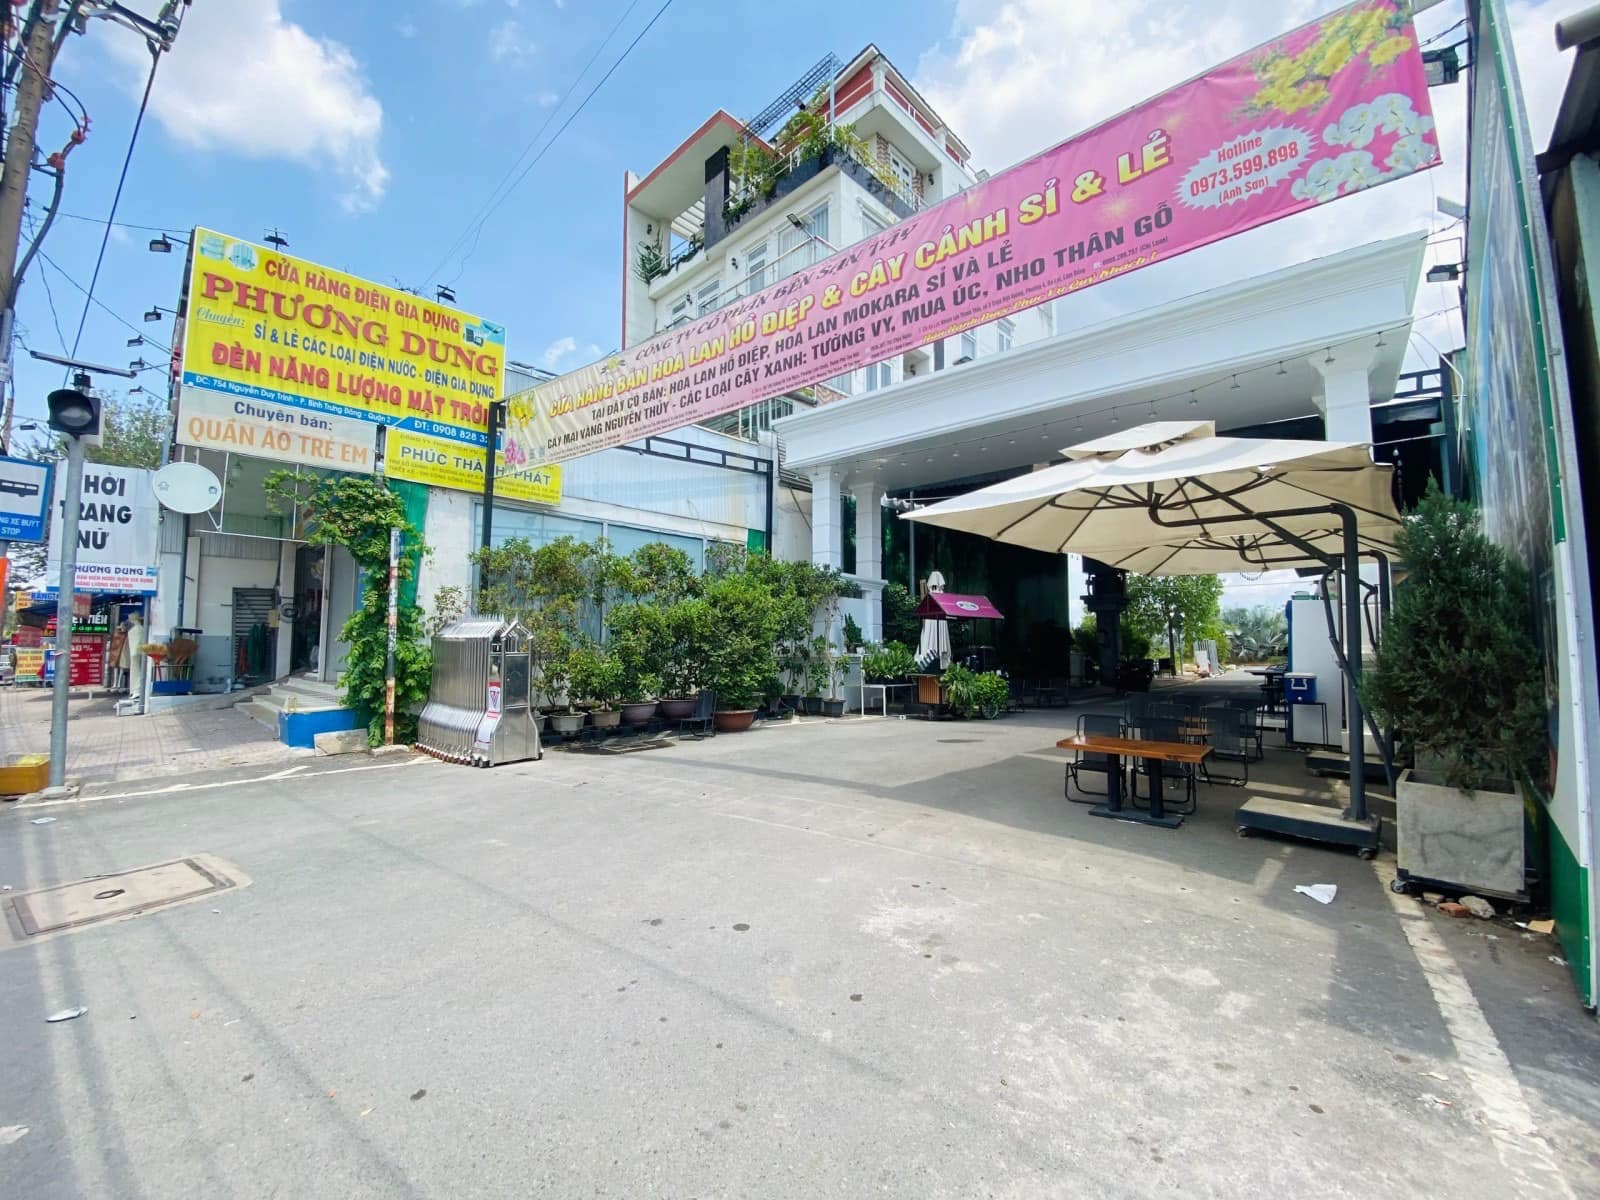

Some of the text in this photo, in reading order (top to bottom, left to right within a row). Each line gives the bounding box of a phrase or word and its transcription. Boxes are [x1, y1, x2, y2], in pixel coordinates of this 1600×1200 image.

[1218, 136, 1263, 163] Hotline
[1190, 141, 1299, 197] 0973.599.898
[1219, 176, 1270, 204] (Anh Sơn)
[575, 383, 614, 410] HÀNG
[616, 366, 648, 395] BÁN
[651, 352, 685, 382] HOA
[688, 335, 726, 368] LAN
[761, 294, 815, 336] ĐIỆP
[821, 284, 844, 310] &
[850, 251, 907, 297] CÂY
[914, 207, 1009, 270] CẢNH
[1018, 177, 1060, 225] SỈ
[1071, 170, 1105, 204] &
[1117, 128, 1173, 185] LẺ
[265, 257, 460, 334] CỬA HÀNG ĐIỆN GIA DỤNG
[201, 271, 499, 378] PHƯƠNG DUNG
[563, 431, 579, 446] MAI
[580, 424, 603, 440] VÀNG
[679, 389, 702, 409] CÁC
[705, 378, 731, 399] LOẠI
[735, 367, 760, 389] CÂY
[764, 351, 807, 379] XANH:
[811, 326, 866, 360] TƯỜNG
[902, 296, 946, 326] MUA
[996, 257, 1046, 291] NHO
[1053, 226, 1125, 269] THÂN
[1134, 199, 1173, 238] GỖ
[669, 376, 690, 395] HOA
[694, 366, 717, 386] LAN
[720, 353, 735, 376] HỒ
[775, 333, 803, 354] HOA
[807, 315, 837, 341] LAN
[842, 284, 920, 326] MOKARA
[952, 256, 980, 282] VÀ
[987, 239, 1014, 269] LẺ
[212, 340, 262, 374] ĐÈN
[268, 355, 330, 389] NĂNG
[336, 372, 402, 405] LƯỢNG
[408, 389, 446, 418] MẶT
[270, 328, 279, 344] &
[283, 328, 299, 349] LẺ
[302, 334, 327, 356] CÁC
[330, 343, 355, 366] LOẠI
[359, 351, 385, 372] ĐIỆN
[388, 357, 417, 379] NƯỚC
[425, 369, 448, 389] ĐIỆN
[451, 375, 467, 393] GIA
[469, 382, 495, 400] DỤNG
[261, 387, 275, 400] Duy
[234, 401, 333, 431] Chuyên bán:
[414, 420, 430, 432] ĐT:
[433, 423, 456, 437] 0908
[459, 430, 477, 441] 828
[261, 426, 292, 452] ÁO
[298, 434, 336, 460] TRẺ
[341, 443, 369, 465] EM
[401, 446, 448, 466] PHÚC
[1, 526, 21, 537] STOP
[77, 527, 109, 550] NỮ
[115, 566, 144, 576] DUNG
